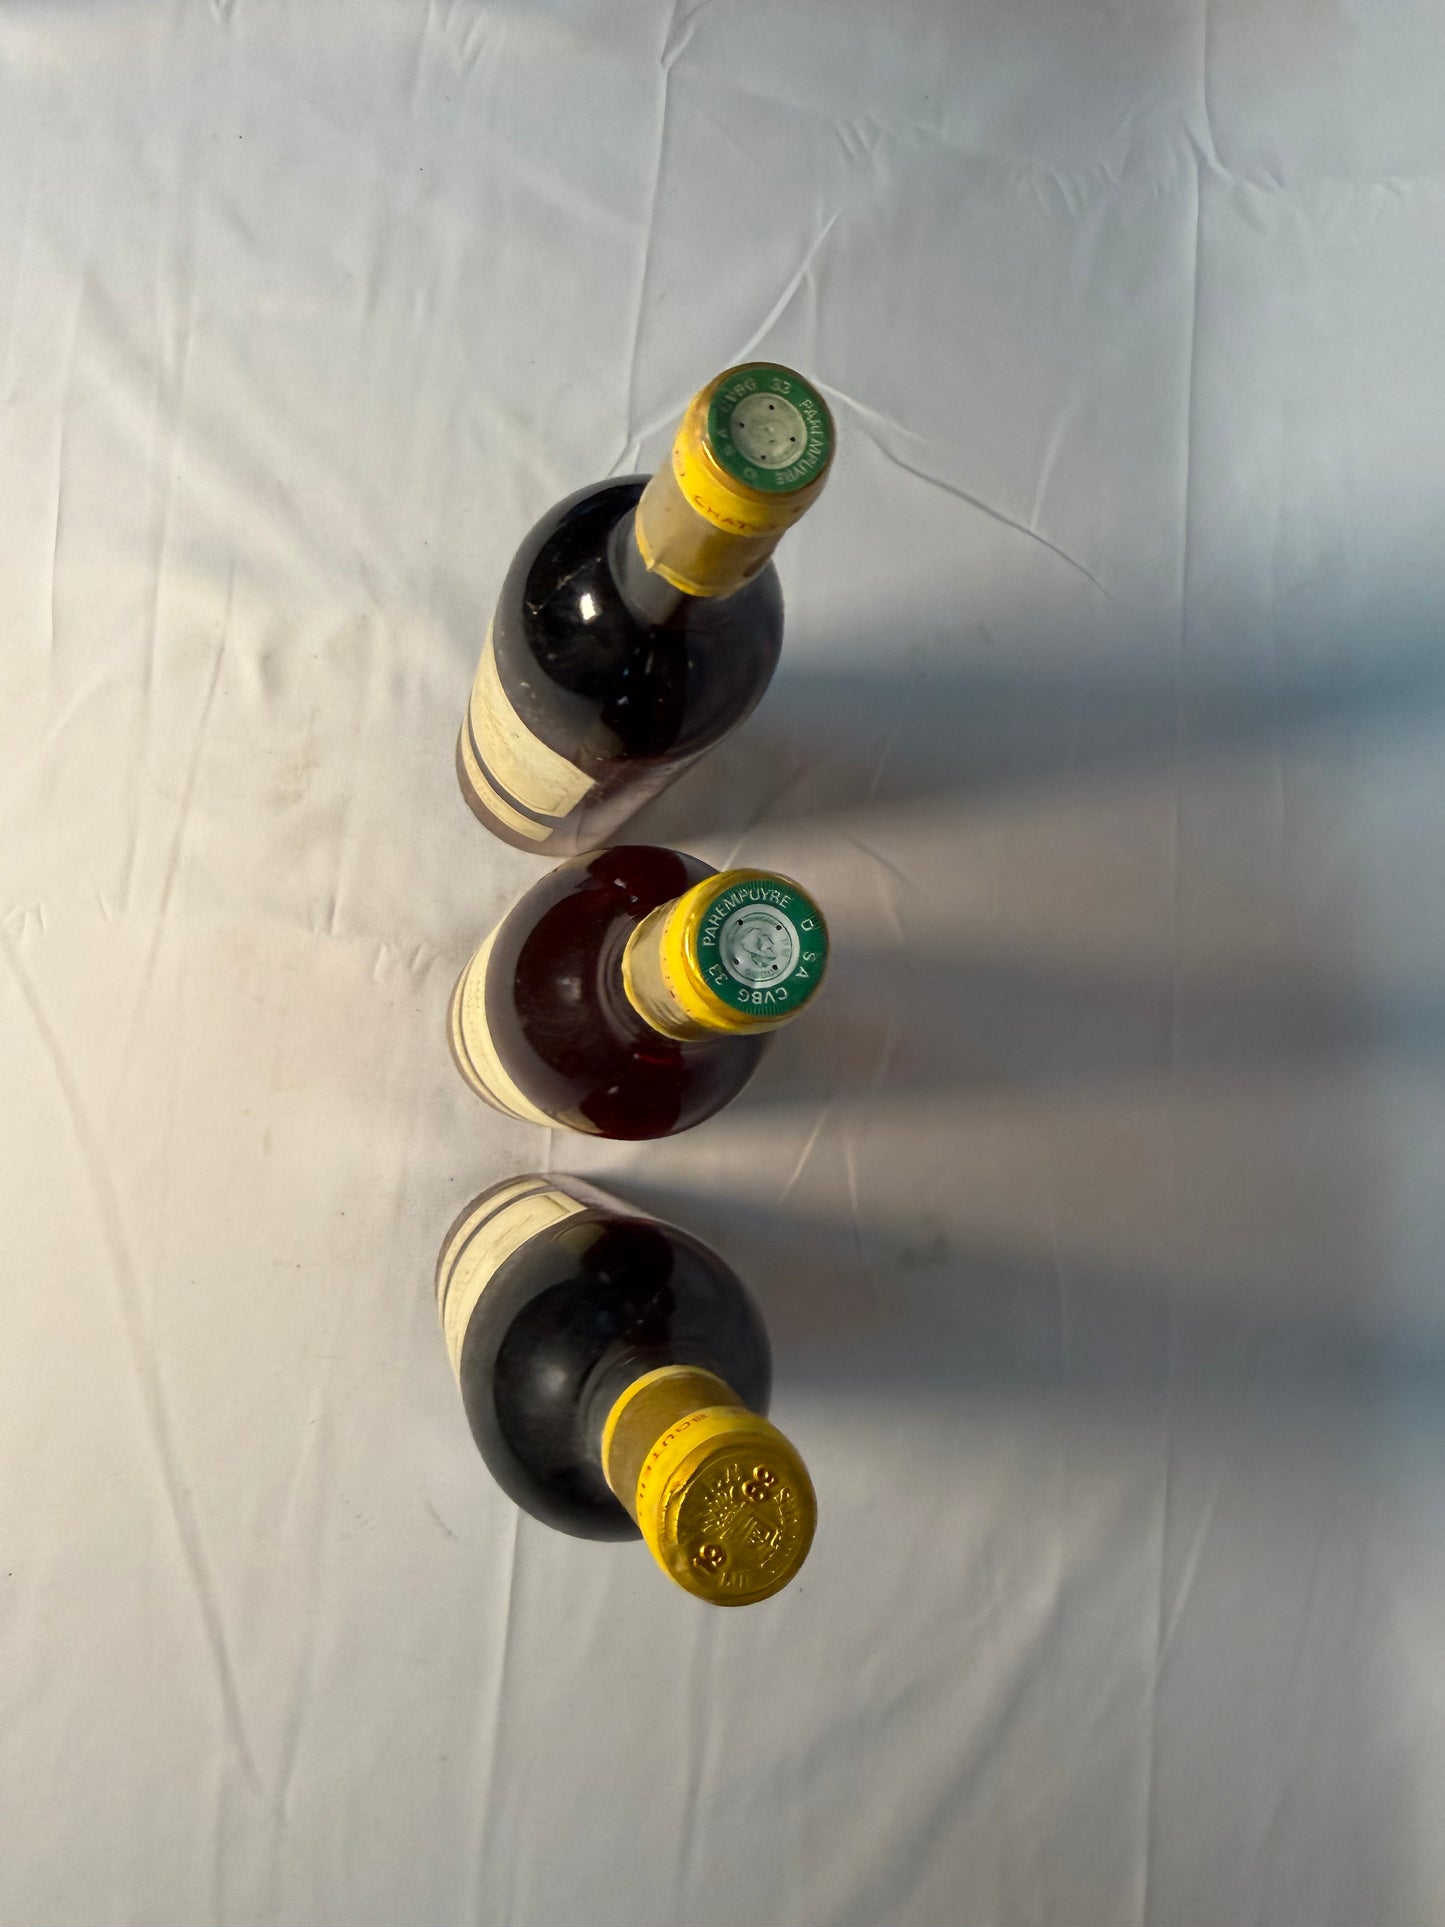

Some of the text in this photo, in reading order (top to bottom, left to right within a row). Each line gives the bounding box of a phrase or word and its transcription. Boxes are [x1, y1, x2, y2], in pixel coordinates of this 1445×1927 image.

[771, 377, 792, 394] 33
[702, 887, 792, 947] PAREMPUYRE
[802, 951, 816, 962] S
[708, 963, 729, 986] 33
[795, 966, 810, 979] A
[737, 986, 788, 1005] CVBG
